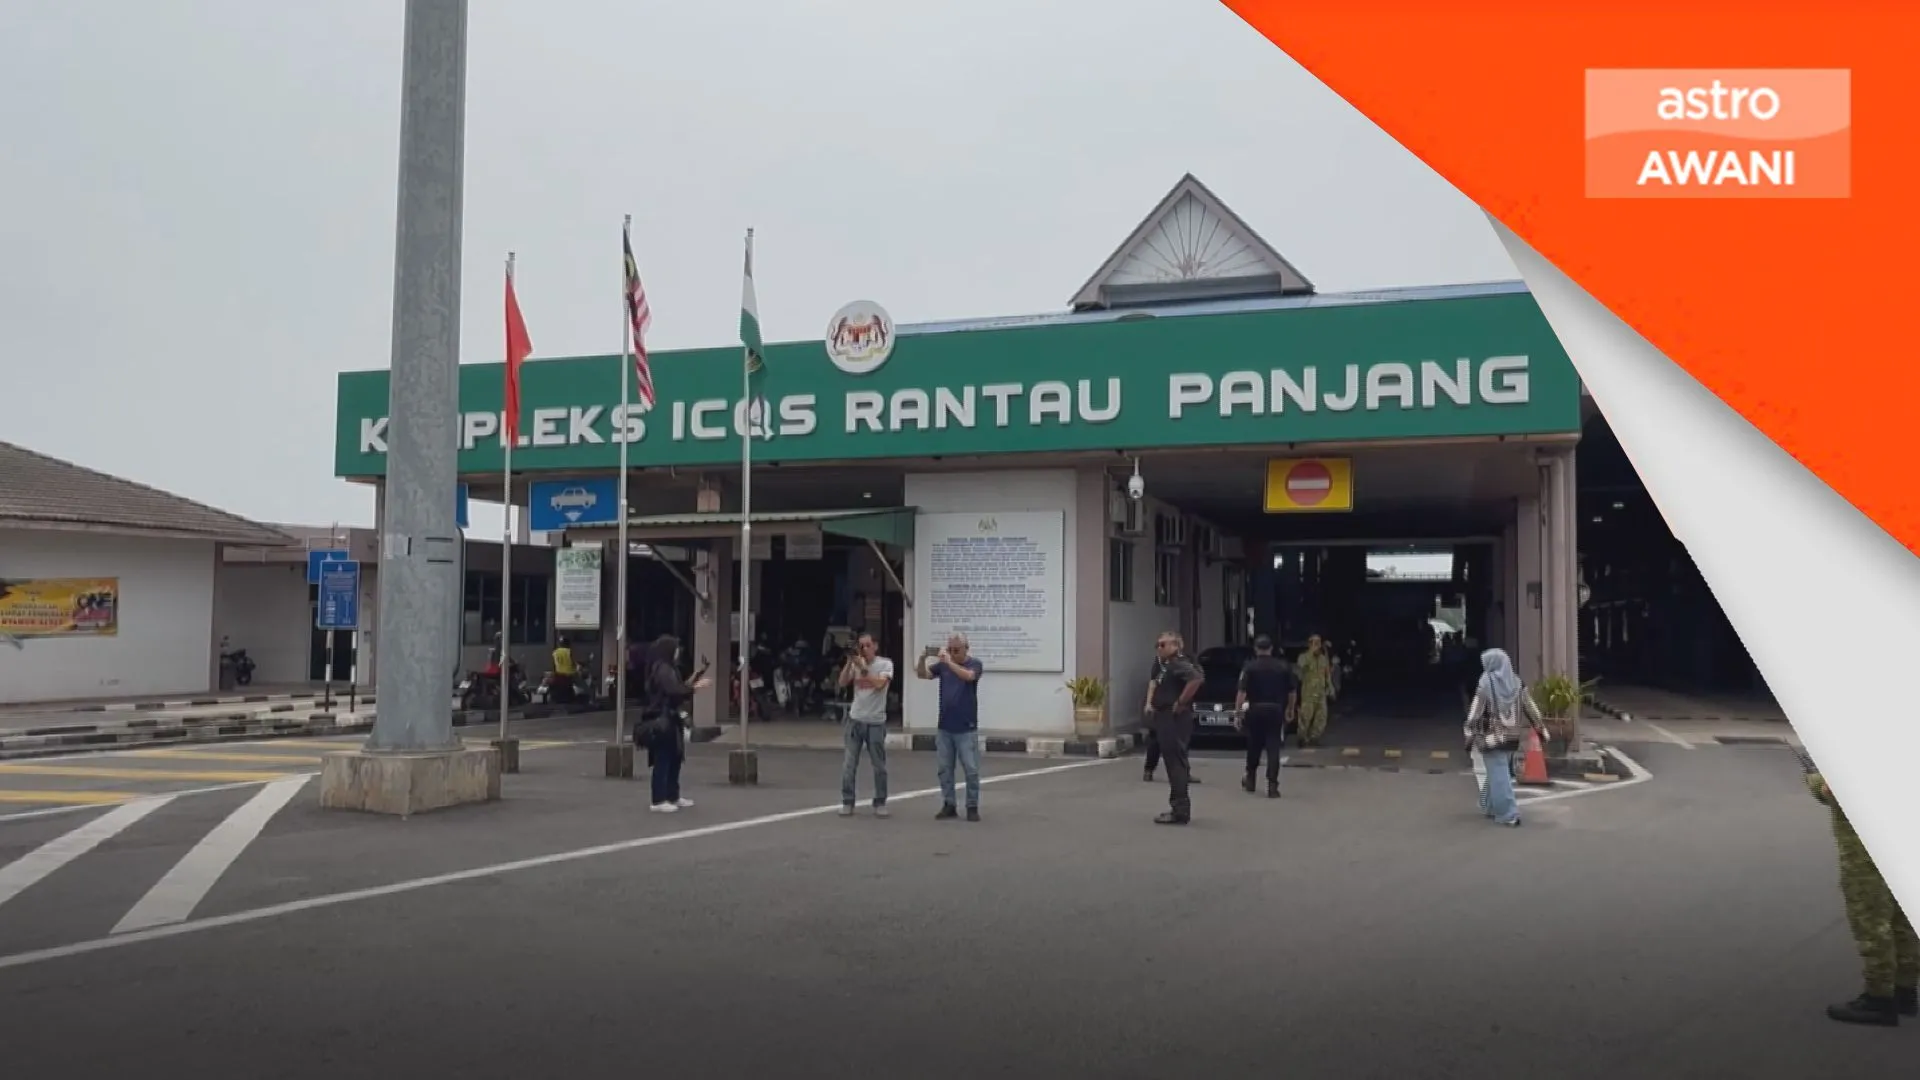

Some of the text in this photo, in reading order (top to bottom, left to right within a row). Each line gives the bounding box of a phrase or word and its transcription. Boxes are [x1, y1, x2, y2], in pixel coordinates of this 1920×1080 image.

[360, 355, 1530, 453] KPLEKS ICQS RANTAU PANJANG
